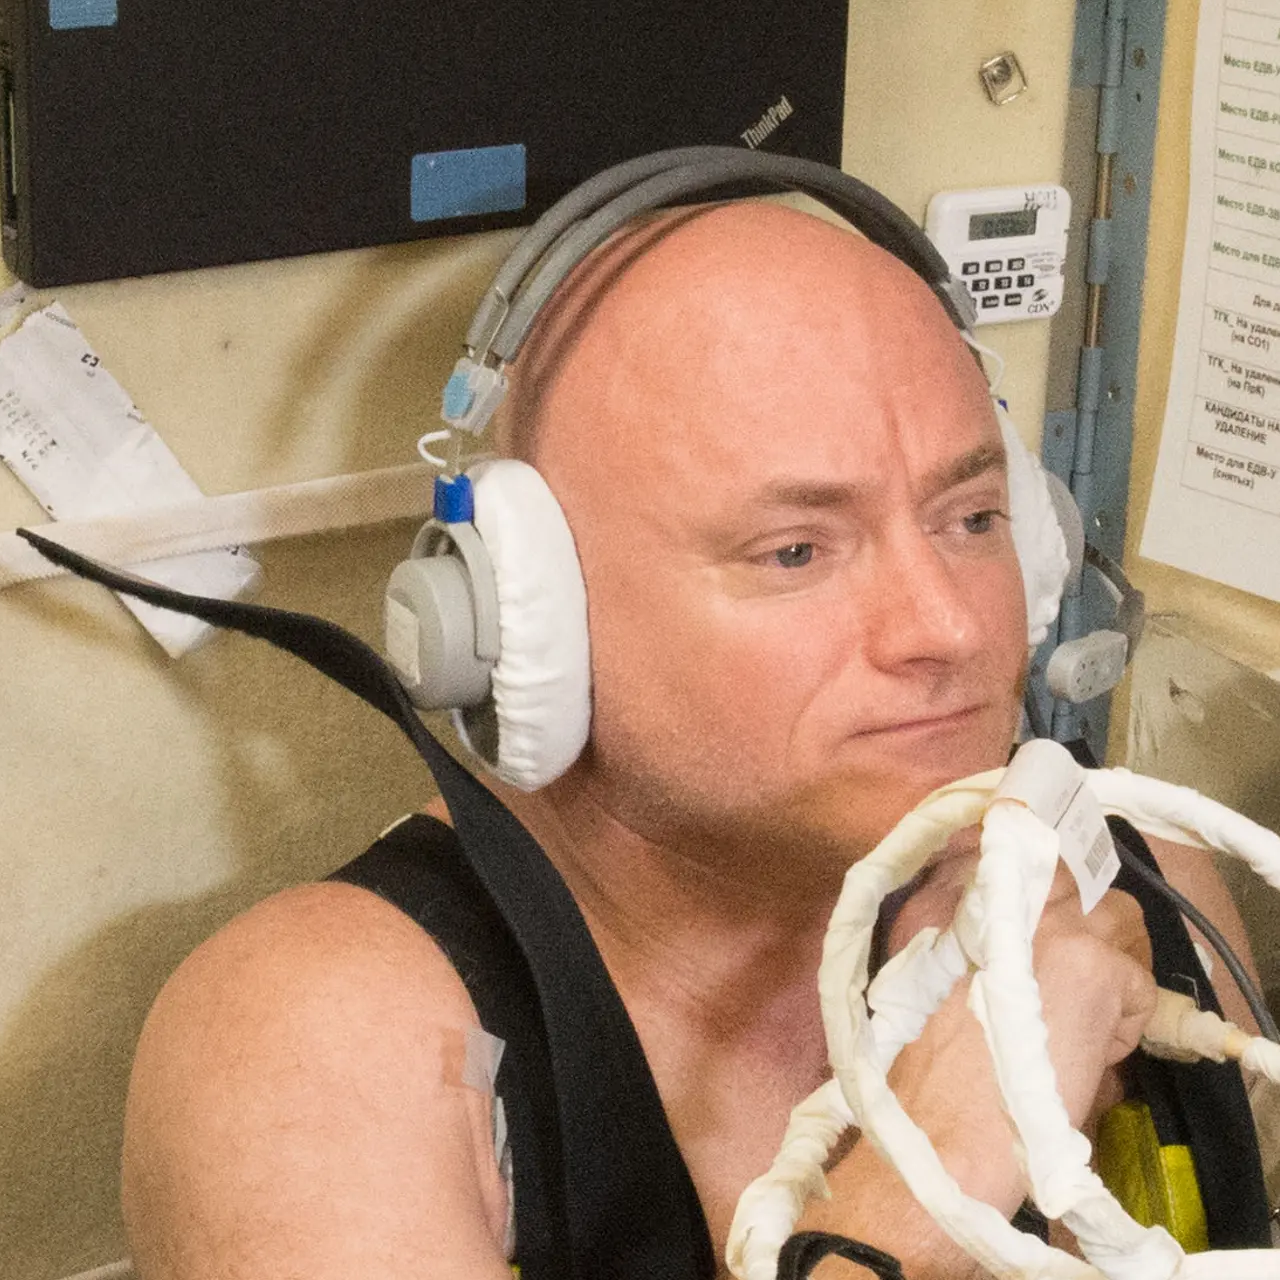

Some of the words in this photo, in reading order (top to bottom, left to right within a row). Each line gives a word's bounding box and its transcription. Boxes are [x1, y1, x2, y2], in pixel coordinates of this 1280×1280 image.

[1223, 54, 1251, 70] Место
[1220, 101, 1247, 118] Место
[740, 95, 794, 149] ThinkPad
[1218, 148, 1246, 165] Место
[1216, 195, 1245, 212] Место
[1212, 241, 1241, 258] Место
[1242, 250, 1261, 264] для
[1253, 295, 1271, 308] Для
[1236, 317, 1249, 329] На
[1231, 332, 1246, 347] (на
[1230, 363, 1243, 375] На
[1227, 378, 1242, 392] (на
[1204, 400, 1266, 430] КАНДИДАТЫ
[1267, 420, 1280, 434] НА
[1215, 420, 1268, 445] УДАЛЕНИЕ
[1196, 445, 1224, 464] Место
[1225, 456, 1246, 470] для
[1212, 468, 1255, 489] (снятых)
